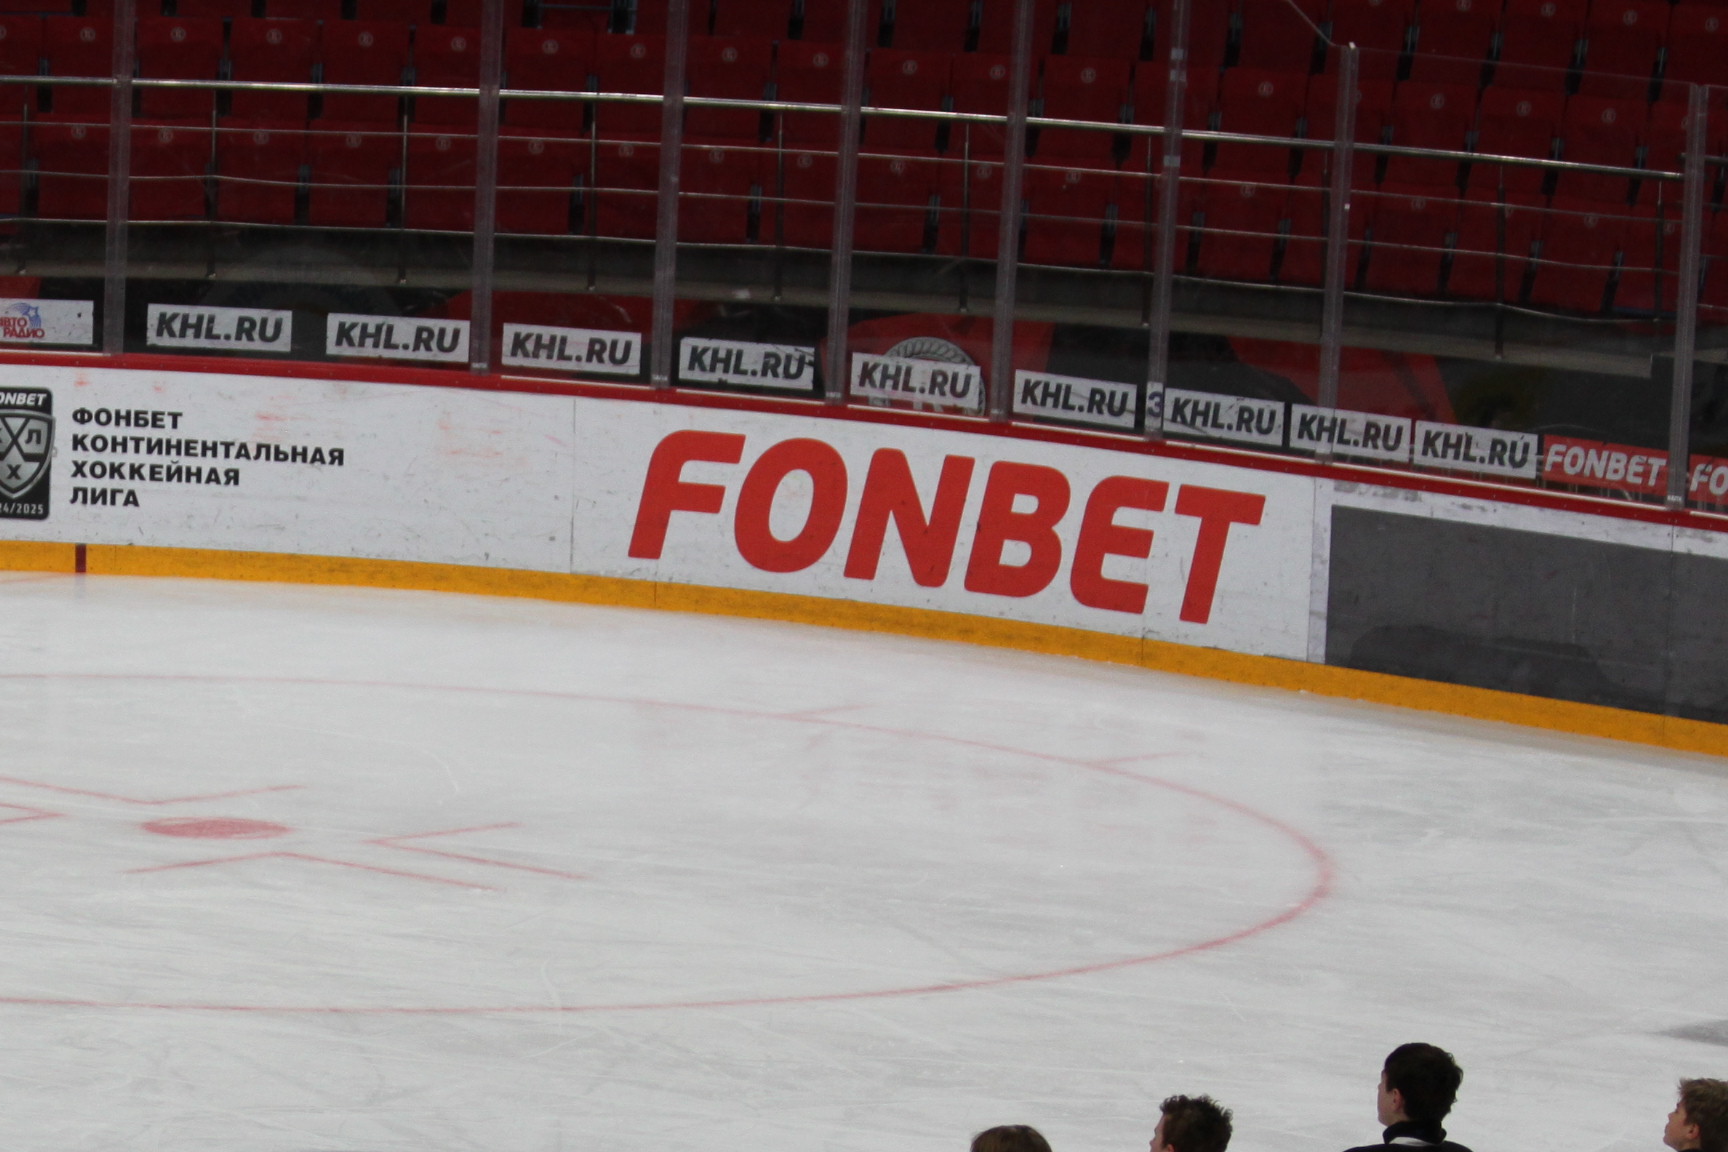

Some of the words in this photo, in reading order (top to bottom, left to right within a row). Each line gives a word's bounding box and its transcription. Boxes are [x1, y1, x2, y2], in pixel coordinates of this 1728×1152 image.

[3, 327, 46, 339] РАДИО
[156, 312, 283, 343] KHL.RU
[335, 321, 461, 353] KHL.RU
[510, 331, 632, 365] KHL.RU
[687, 345, 806, 379] KHL.RU
[858, 360, 972, 398] KHL.RU
[1020, 378, 1128, 417] KHL.RU
[72, 407, 183, 430] ФОНБЕТ
[1172, 397, 1276, 435] KHL.RU
[1298, 413, 1404, 451] KHL.RU
[25, 429, 42, 445] Л
[72, 434, 345, 466] КОНТИНЕНТАЛЬНАЯ
[1422, 429, 1529, 469] KHL.RU
[71, 460, 240, 486] ХОККЕЙНАЯ
[1544, 444, 1667, 487] FONBET
[70, 487, 140, 507] ЛИГА
[627, 429, 1267, 624] FONBET
